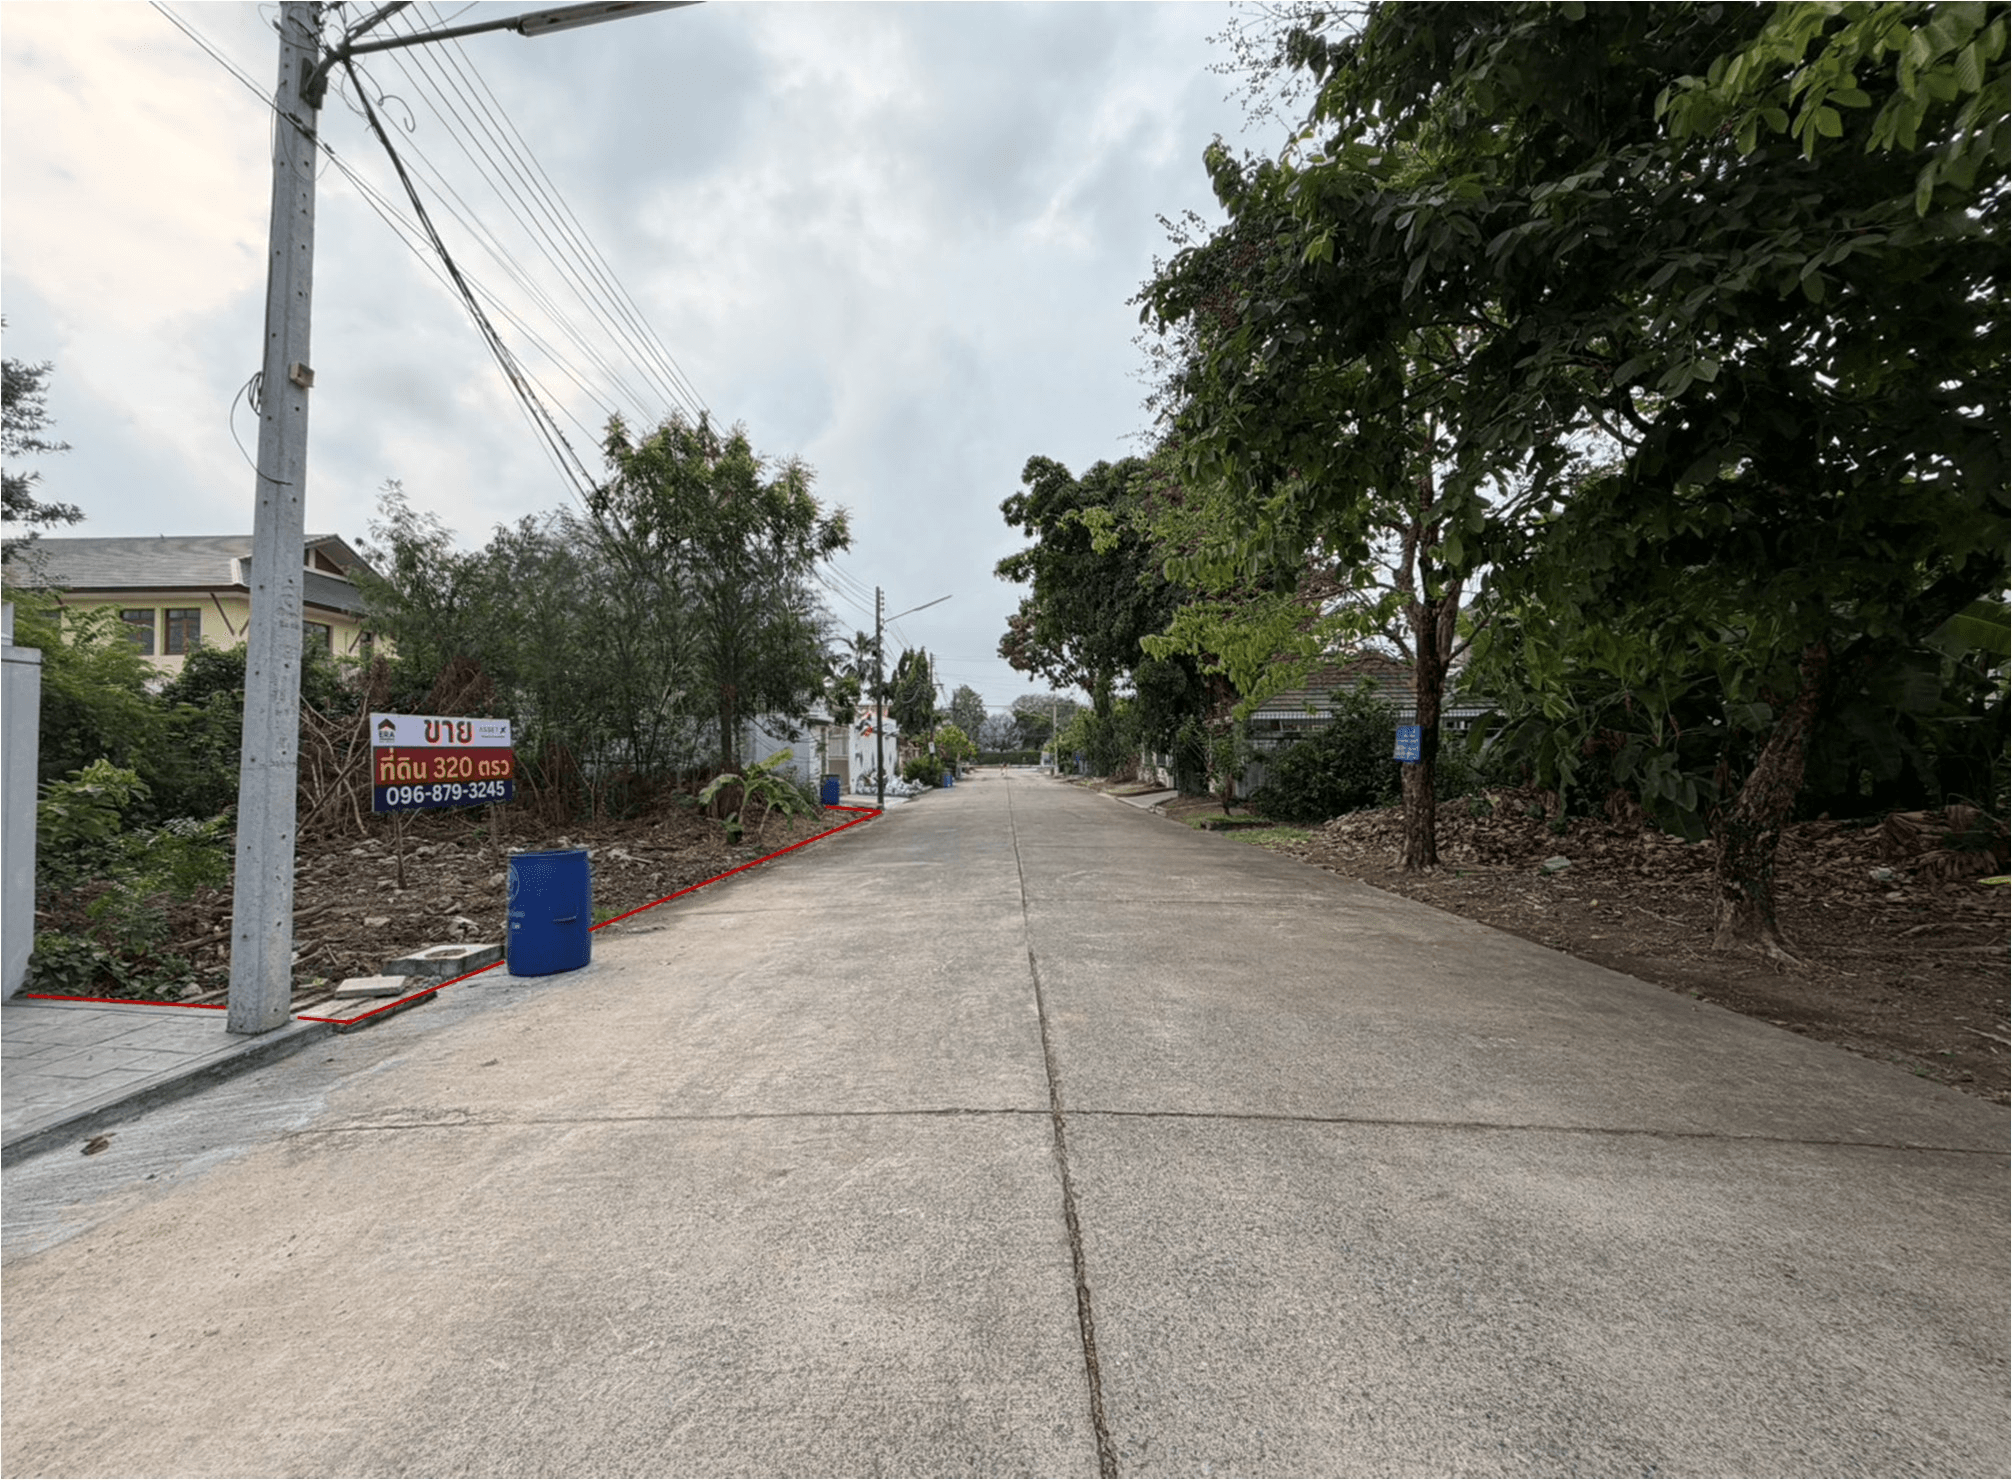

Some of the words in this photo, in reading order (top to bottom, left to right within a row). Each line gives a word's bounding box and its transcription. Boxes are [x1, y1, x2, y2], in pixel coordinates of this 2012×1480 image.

[424, 719, 474, 745] ขาย
[380, 747, 427, 781] ที่ดิน
[433, 756, 473, 779] 320
[478, 759, 510, 776] ตรว
[386, 781, 506, 806] 096-879-3245
